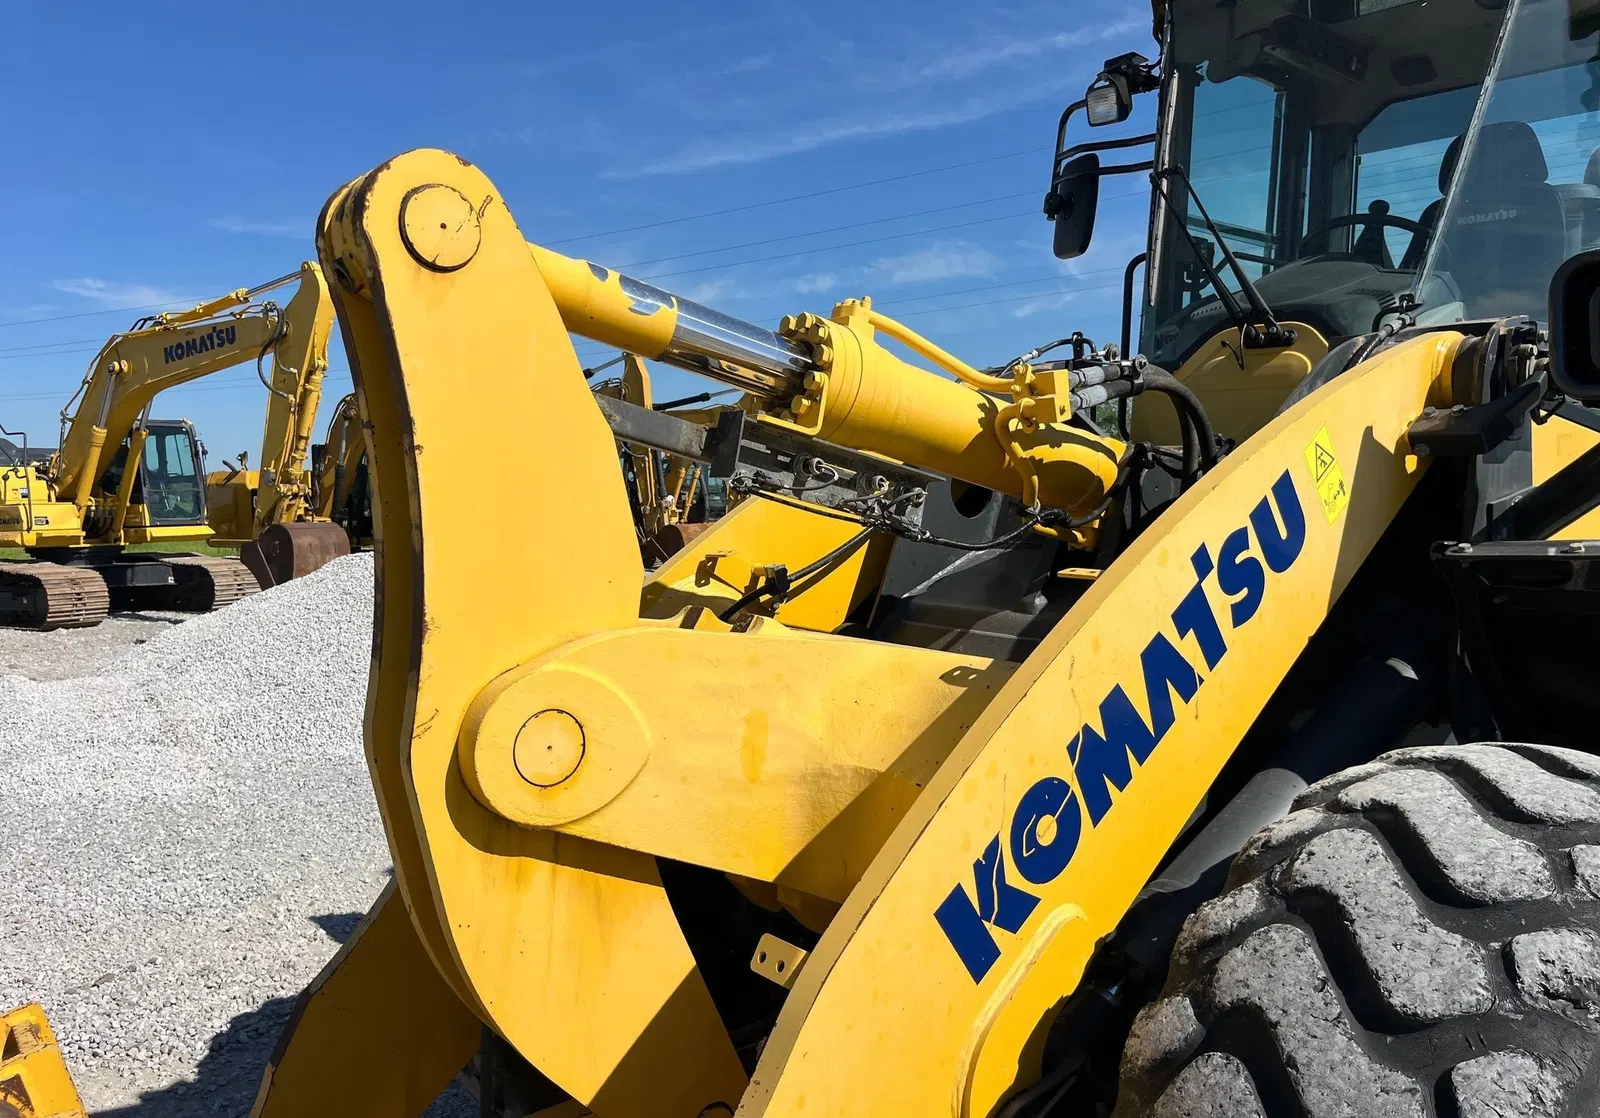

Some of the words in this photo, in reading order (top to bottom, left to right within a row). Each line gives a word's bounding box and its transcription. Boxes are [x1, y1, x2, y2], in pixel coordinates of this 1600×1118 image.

[1457, 208, 1518, 225] KOMATSU
[163, 325, 237, 365] KOMATSU
[934, 469, 1306, 985] KOMATSU
